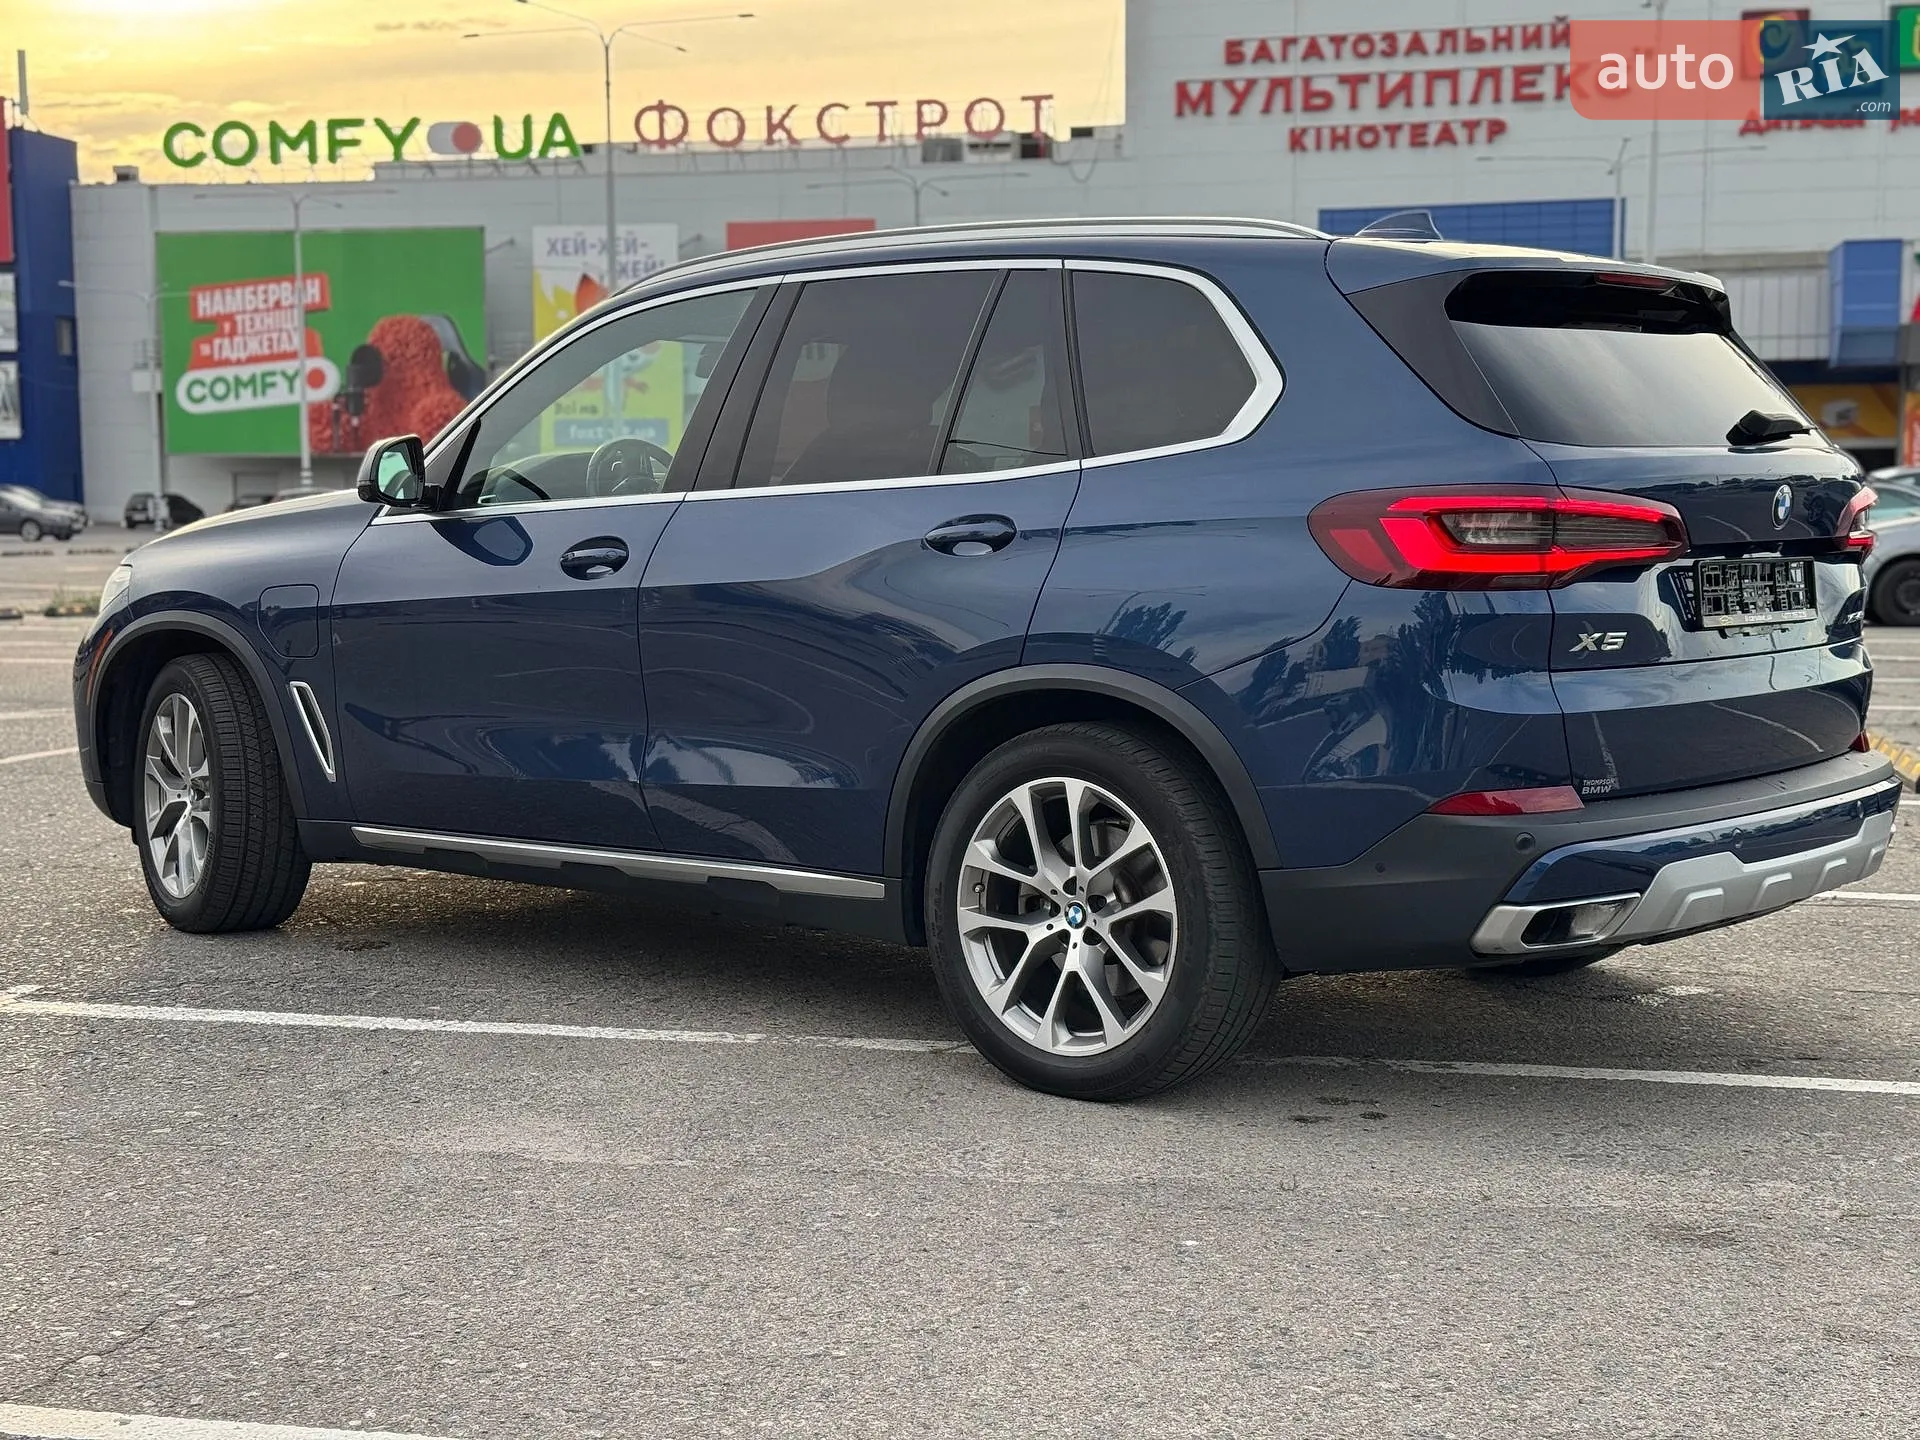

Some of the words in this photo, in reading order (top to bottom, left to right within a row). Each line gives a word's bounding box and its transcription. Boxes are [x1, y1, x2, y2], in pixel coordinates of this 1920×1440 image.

[1223, 16, 1571, 66] БАГАТОЗАЛЬНИЙ
[163, 116, 420, 168] COMFY
[493, 112, 582, 161] UA
[633, 94, 1055, 152] ФОКСТРОТ
[1288, 118, 1508, 152] КІНОТЕАТР
[187, 368, 300, 404] COMFY
[1568, 631, 1628, 652] X5
[1581, 785, 1612, 795] BMW
